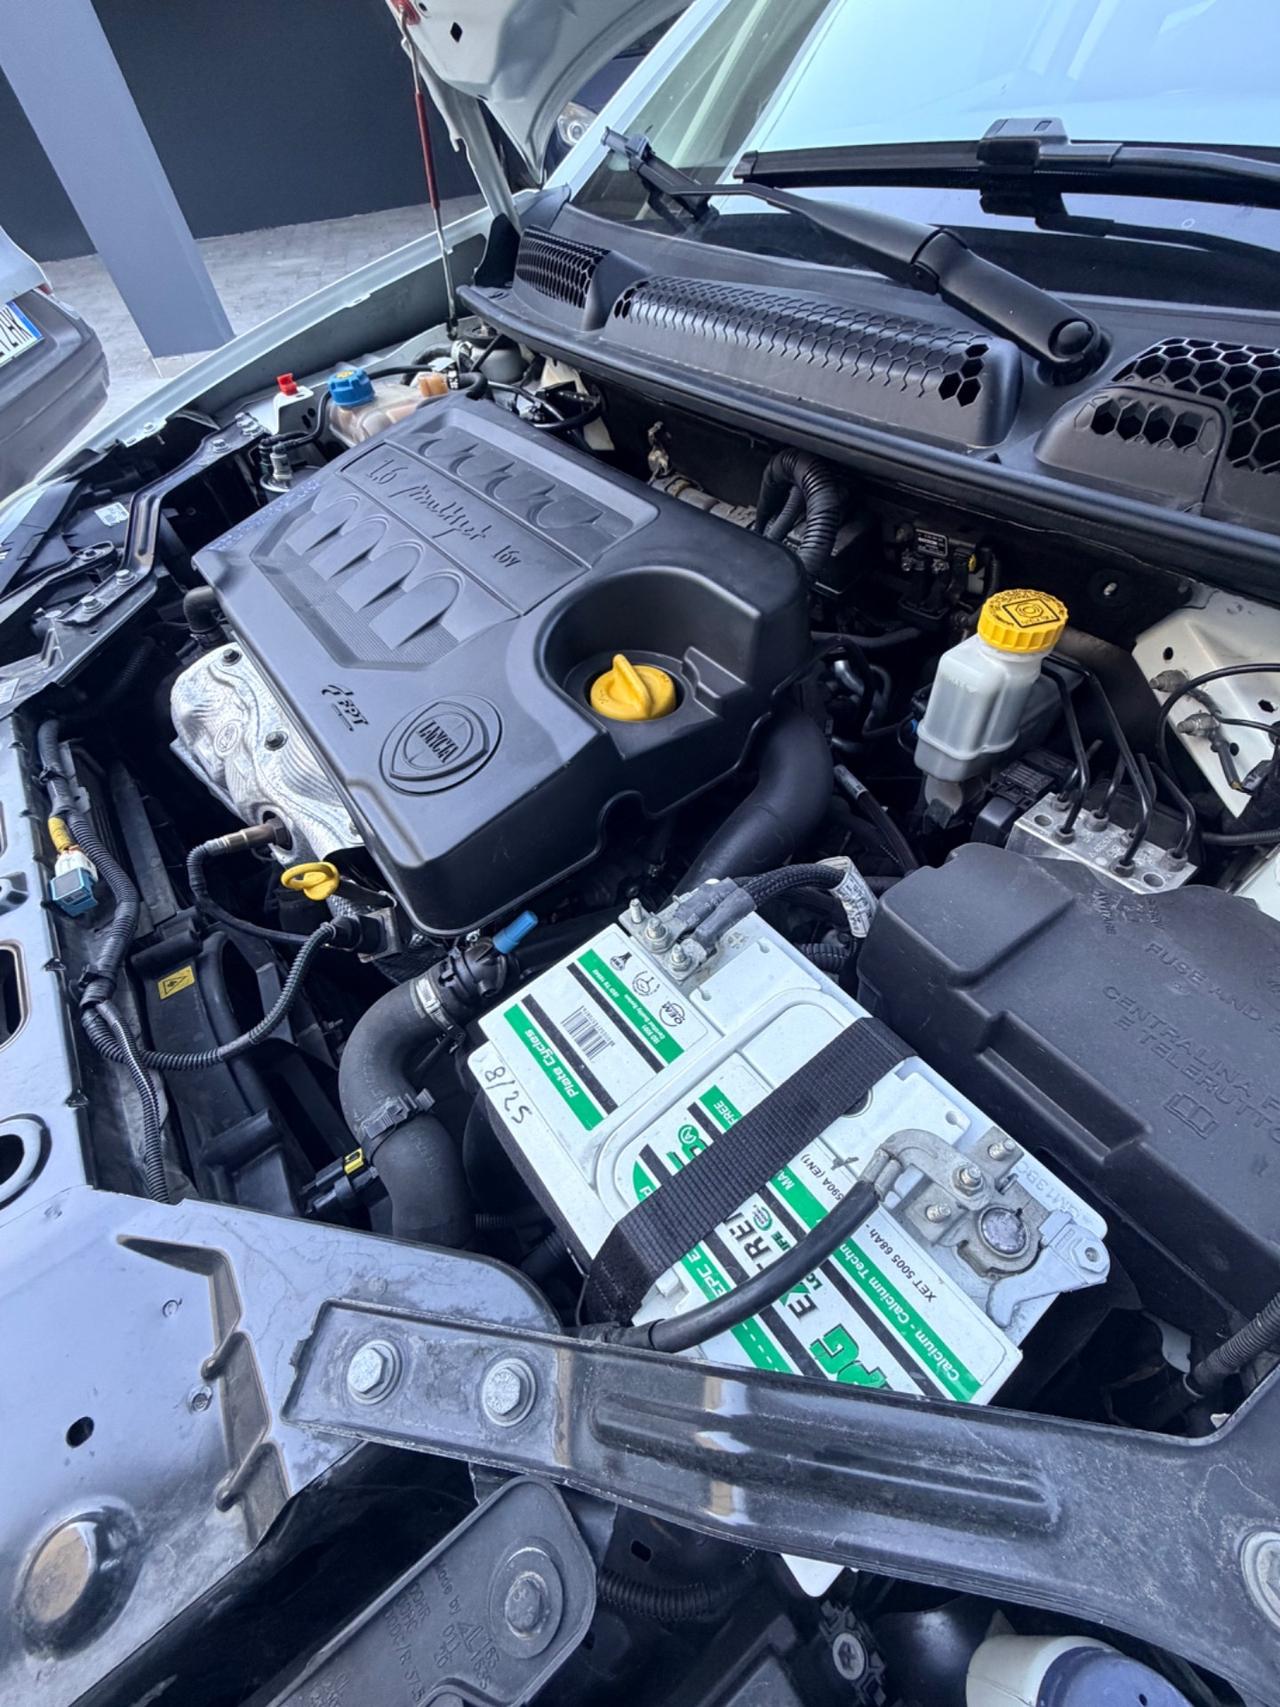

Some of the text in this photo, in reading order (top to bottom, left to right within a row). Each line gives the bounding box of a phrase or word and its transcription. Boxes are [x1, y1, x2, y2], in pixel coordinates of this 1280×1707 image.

[417, 719, 460, 764] LANCIA
[1143, 941, 1209, 988] FUSE
[523, 1027, 580, 1098] Plate Cycles
[1101, 983, 1258, 1099] CENTRALINA
[483, 1064, 533, 1126] 8/25
[799, 1152, 826, 1179] (EN1)
[867, 1227, 895, 1256] 68Ah
[890, 1252, 917, 1280] 5005
[912, 1276, 938, 1303] XET
[866, 1275, 911, 1325] Calcium
[912, 1328, 961, 1383] Calcium
